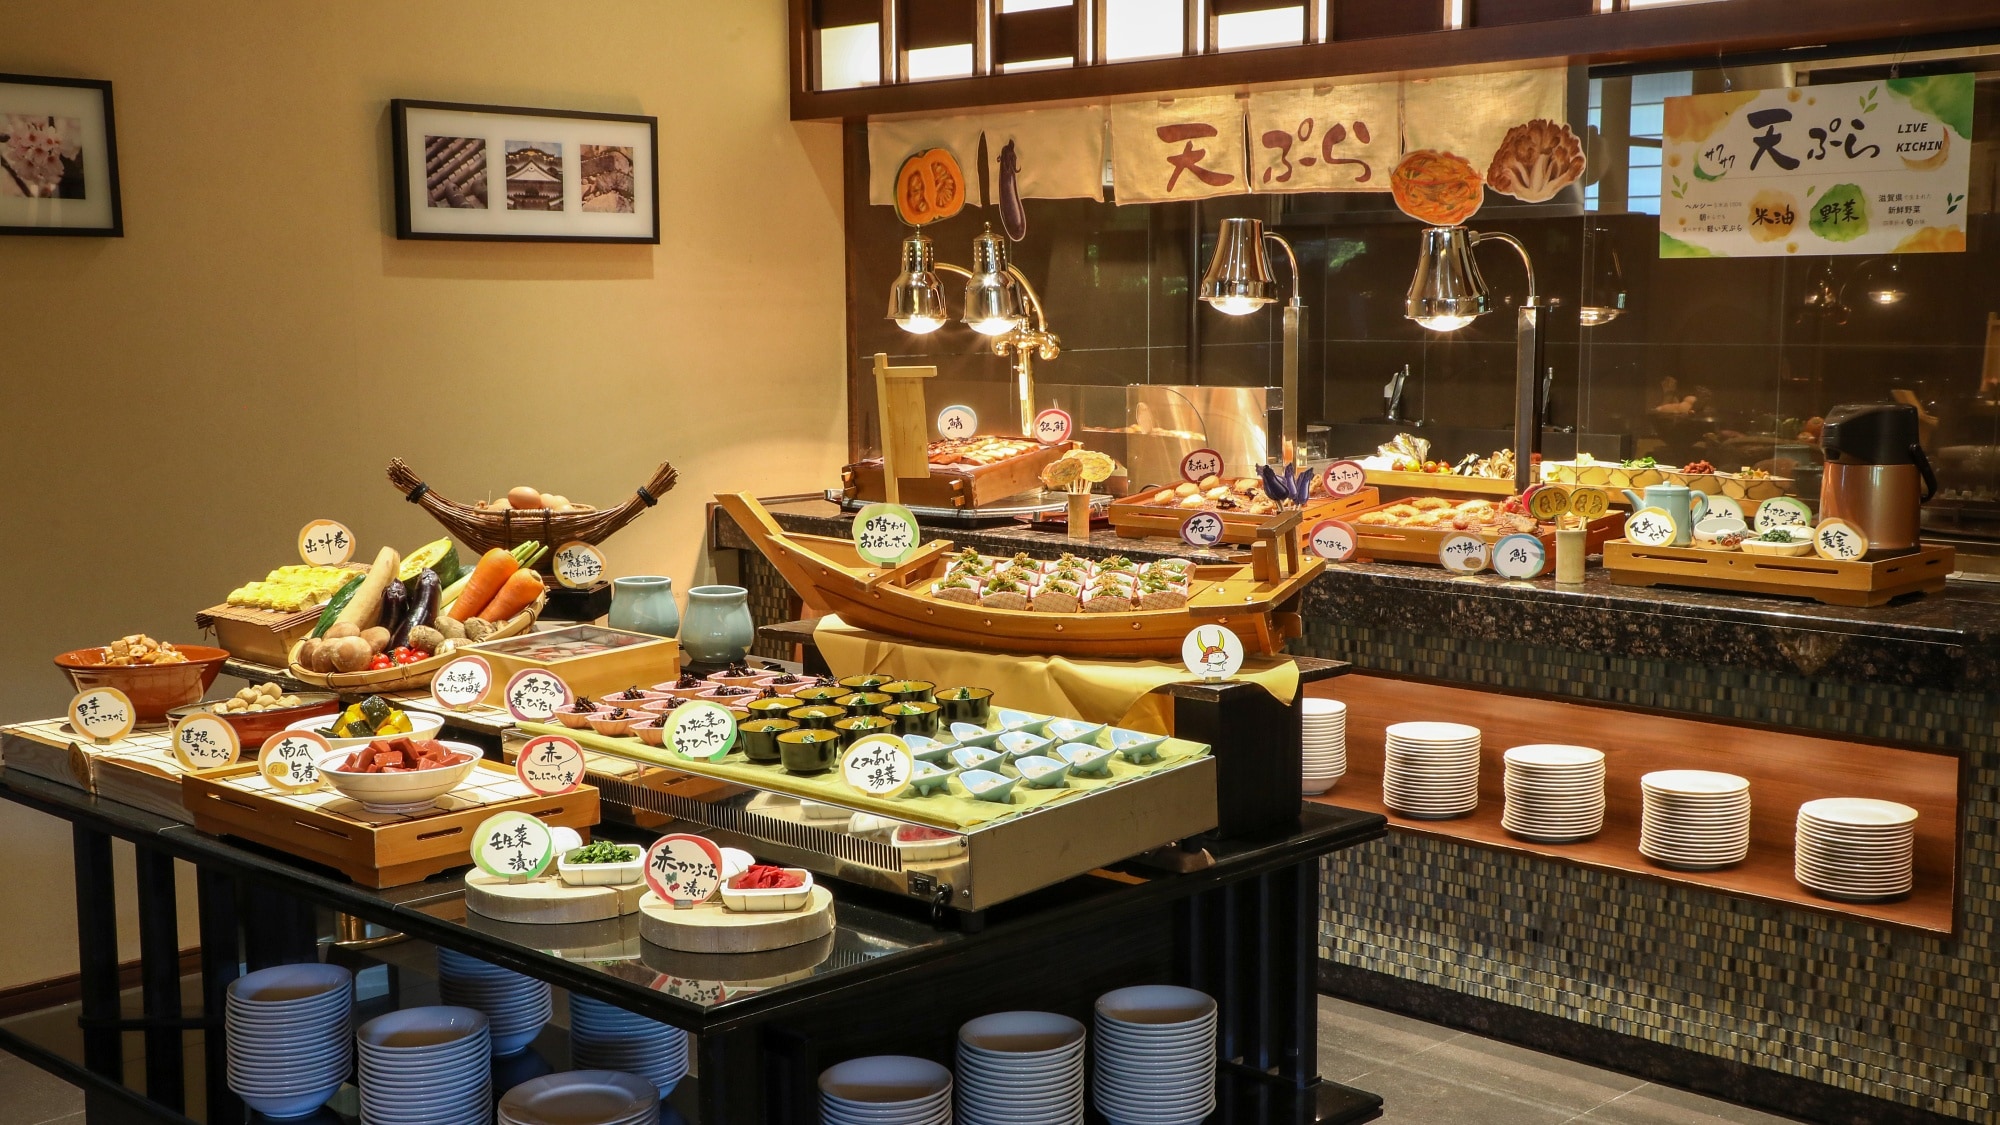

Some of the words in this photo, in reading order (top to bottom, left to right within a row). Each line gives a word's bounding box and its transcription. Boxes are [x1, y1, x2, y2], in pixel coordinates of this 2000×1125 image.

[1897, 122, 1929, 134] LIVE
[1747, 108, 1880, 171] 天ぷら
[1896, 141, 1943, 153] KICHIN
[1156, 117, 1372, 192] 天ぷら
[1751, 204, 1796, 226] 米油
[1819, 198, 1860, 225] 野菜
[1888, 205, 1921, 215] 新鮮野菜
[1039, 419, 1065, 433] 銀鮭
[1329, 470, 1360, 483] まいたけ
[865, 516, 907, 533] 日替わり
[1189, 518, 1216, 535] 茄子
[304, 530, 349, 556] 出汁巻
[860, 533, 913, 549] おばんざい
[1446, 541, 1487, 557] かき揚げ
[1820, 530, 1849, 549] 黄金
[1509, 548, 1527, 563] 鮎
[1840, 546, 1859, 558] だし
[446, 670, 476, 684] 永源寺
[523, 677, 556, 697] 茄子の
[77, 697, 101, 717] 里芋
[511, 690, 555, 711] 煮びたし
[675, 712, 726, 735] 小松菜の
[181, 727, 216, 746] 蓮根の
[677, 729, 731, 753] おひたし
[190, 743, 231, 762] きんぴら
[279, 738, 314, 762] 南瓜
[540, 740, 563, 763] 赤
[850, 744, 900, 770] くみあげ
[291, 761, 320, 783] 旨煮
[527, 770, 577, 786] こんにゃく煮
[867, 765, 902, 790] 湯葉
[489, 824, 533, 851] 壬生菜
[508, 850, 539, 873] 漬け
[651, 845, 718, 882] 赤かぶら
[683, 878, 708, 899] 漬け
